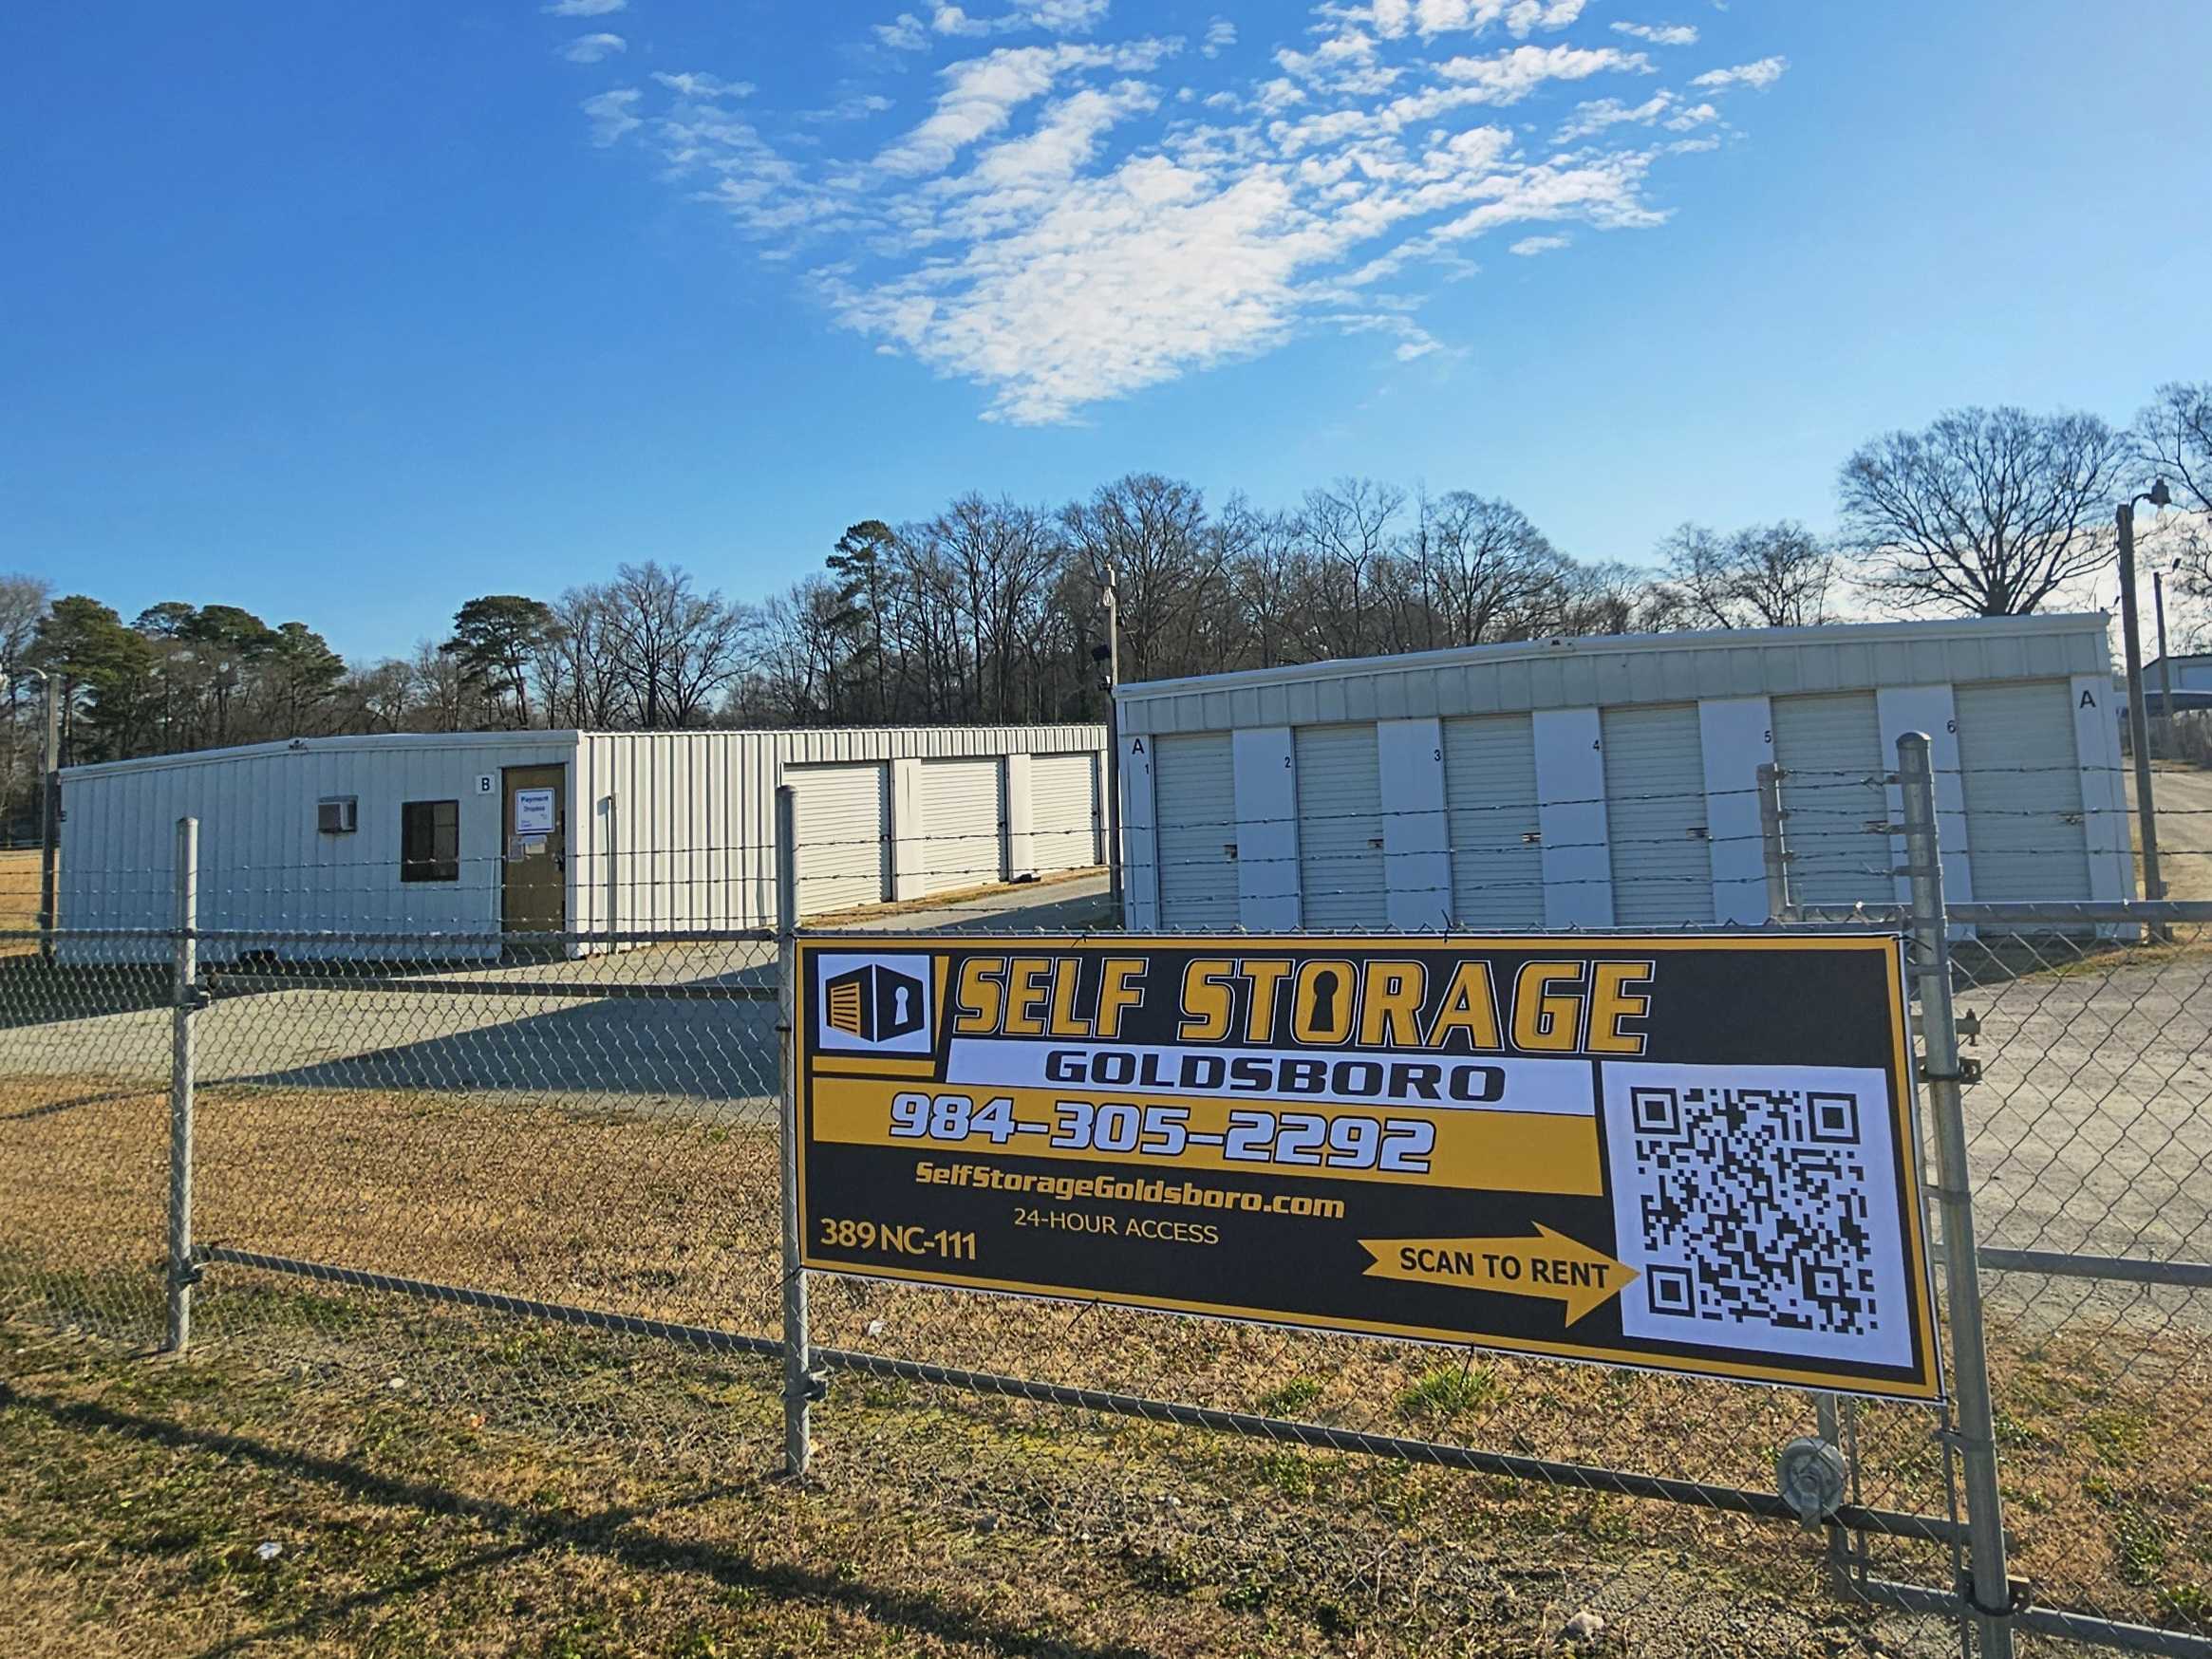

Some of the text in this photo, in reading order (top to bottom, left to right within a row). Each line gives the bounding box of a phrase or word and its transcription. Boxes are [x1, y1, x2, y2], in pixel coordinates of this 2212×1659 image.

[2079, 689, 2096, 709] A
[1946, 719, 1957, 734] 6
[1592, 739, 1600, 752] 4
[1764, 730, 1771, 743] 5
[1132, 738, 1145, 755] A
[1434, 749, 1441, 761] 3
[1144, 763, 1149, 774] 1
[1284, 756, 1291, 768] 2
[481, 777, 490, 791] B
[952, 956, 1656, 1055] SELF STORAGE
[1045, 1050, 1506, 1103] GOLDSBORO
[889, 1091, 1436, 1174] 984-305-2292
[915, 1162, 1345, 1219] SelfStorageGoldsboro.com
[1014, 1207, 1220, 1245] 24-HOUR ACCESS
[820, 1218, 977, 1261] 389 NC-111
[1399, 1247, 1610, 1289] SCAN TO RENT
